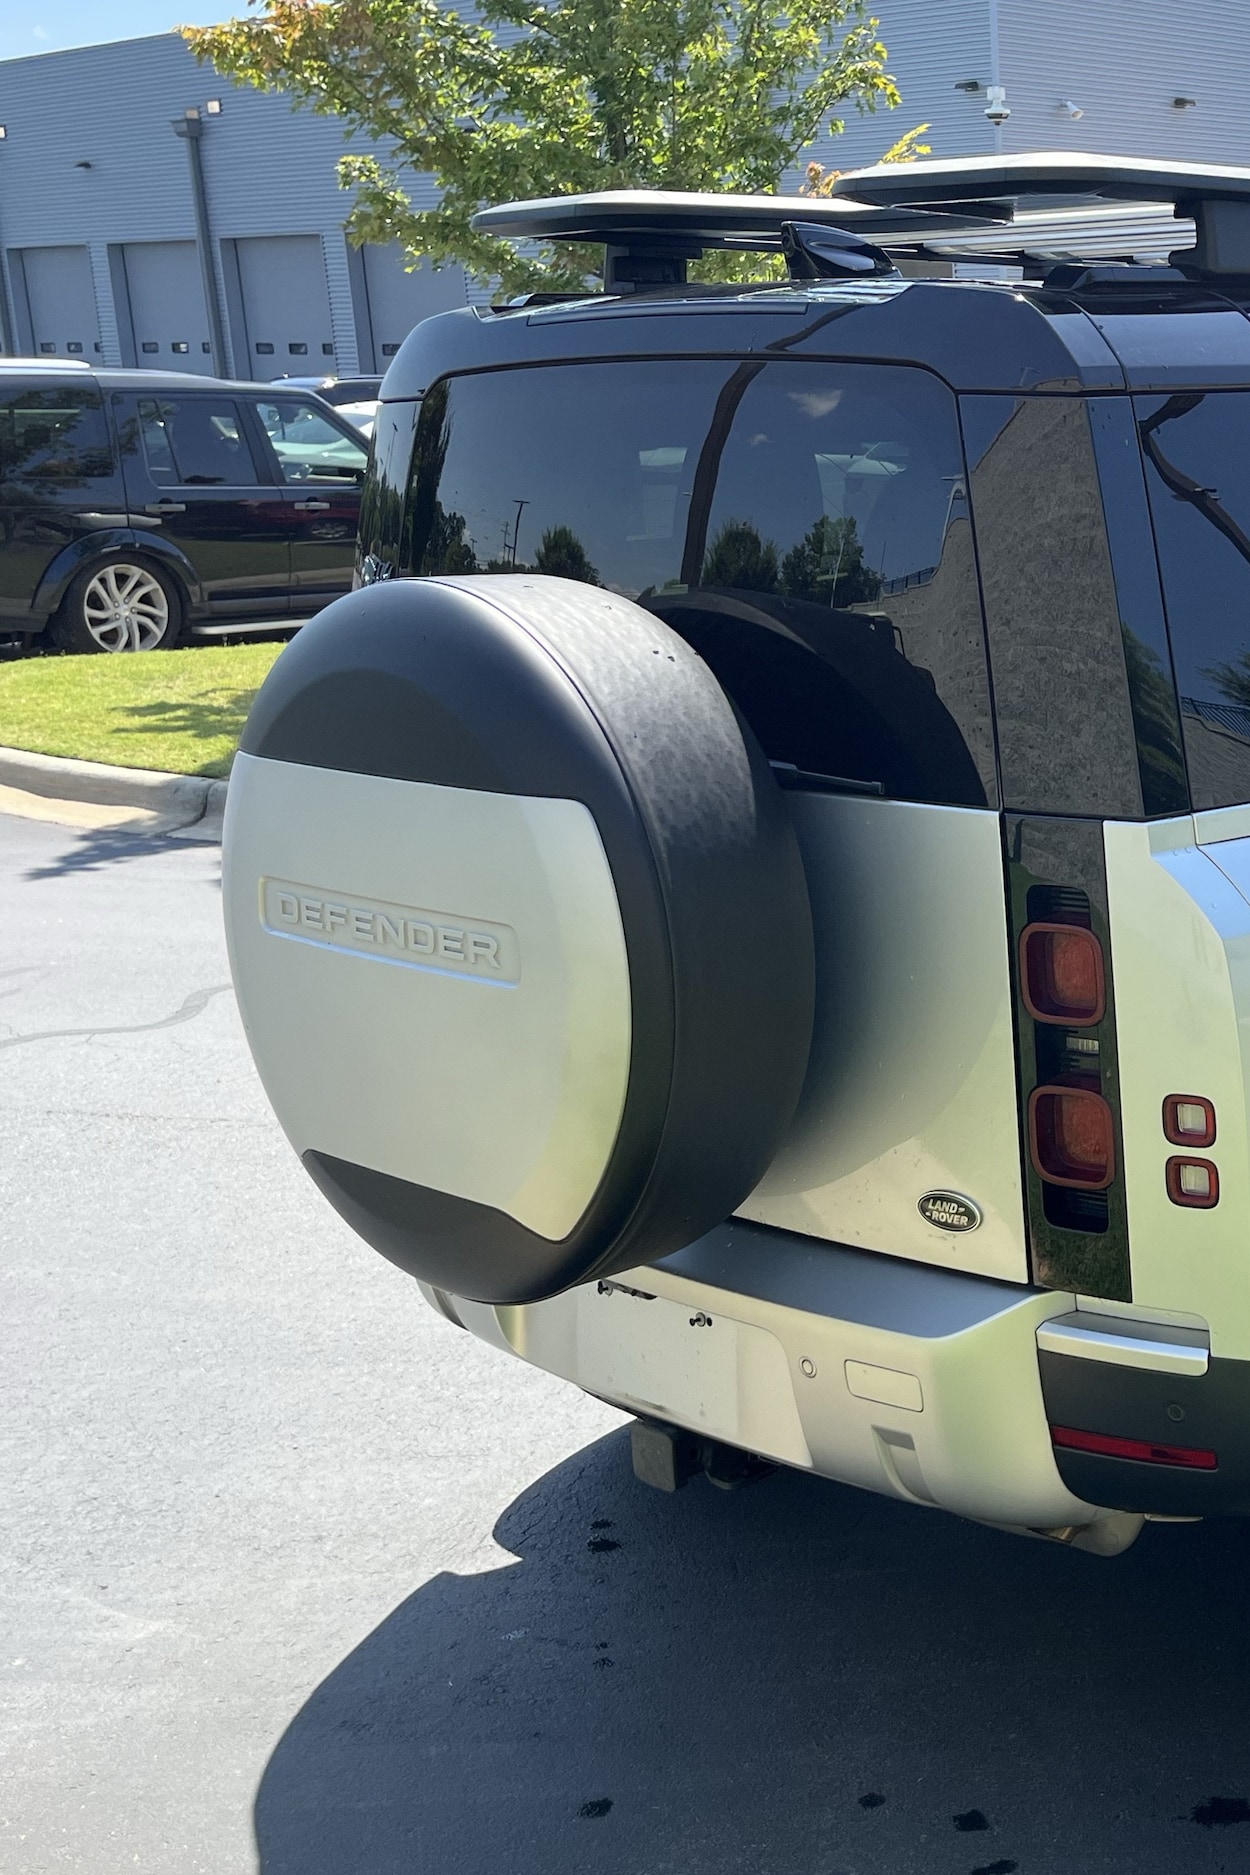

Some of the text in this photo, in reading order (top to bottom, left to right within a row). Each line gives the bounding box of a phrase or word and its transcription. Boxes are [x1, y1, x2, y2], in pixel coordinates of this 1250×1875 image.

[275, 891, 502, 969] DEFENDER
[928, 1199, 959, 1214] LAND
[931, 1210, 969, 1226] ROVER
